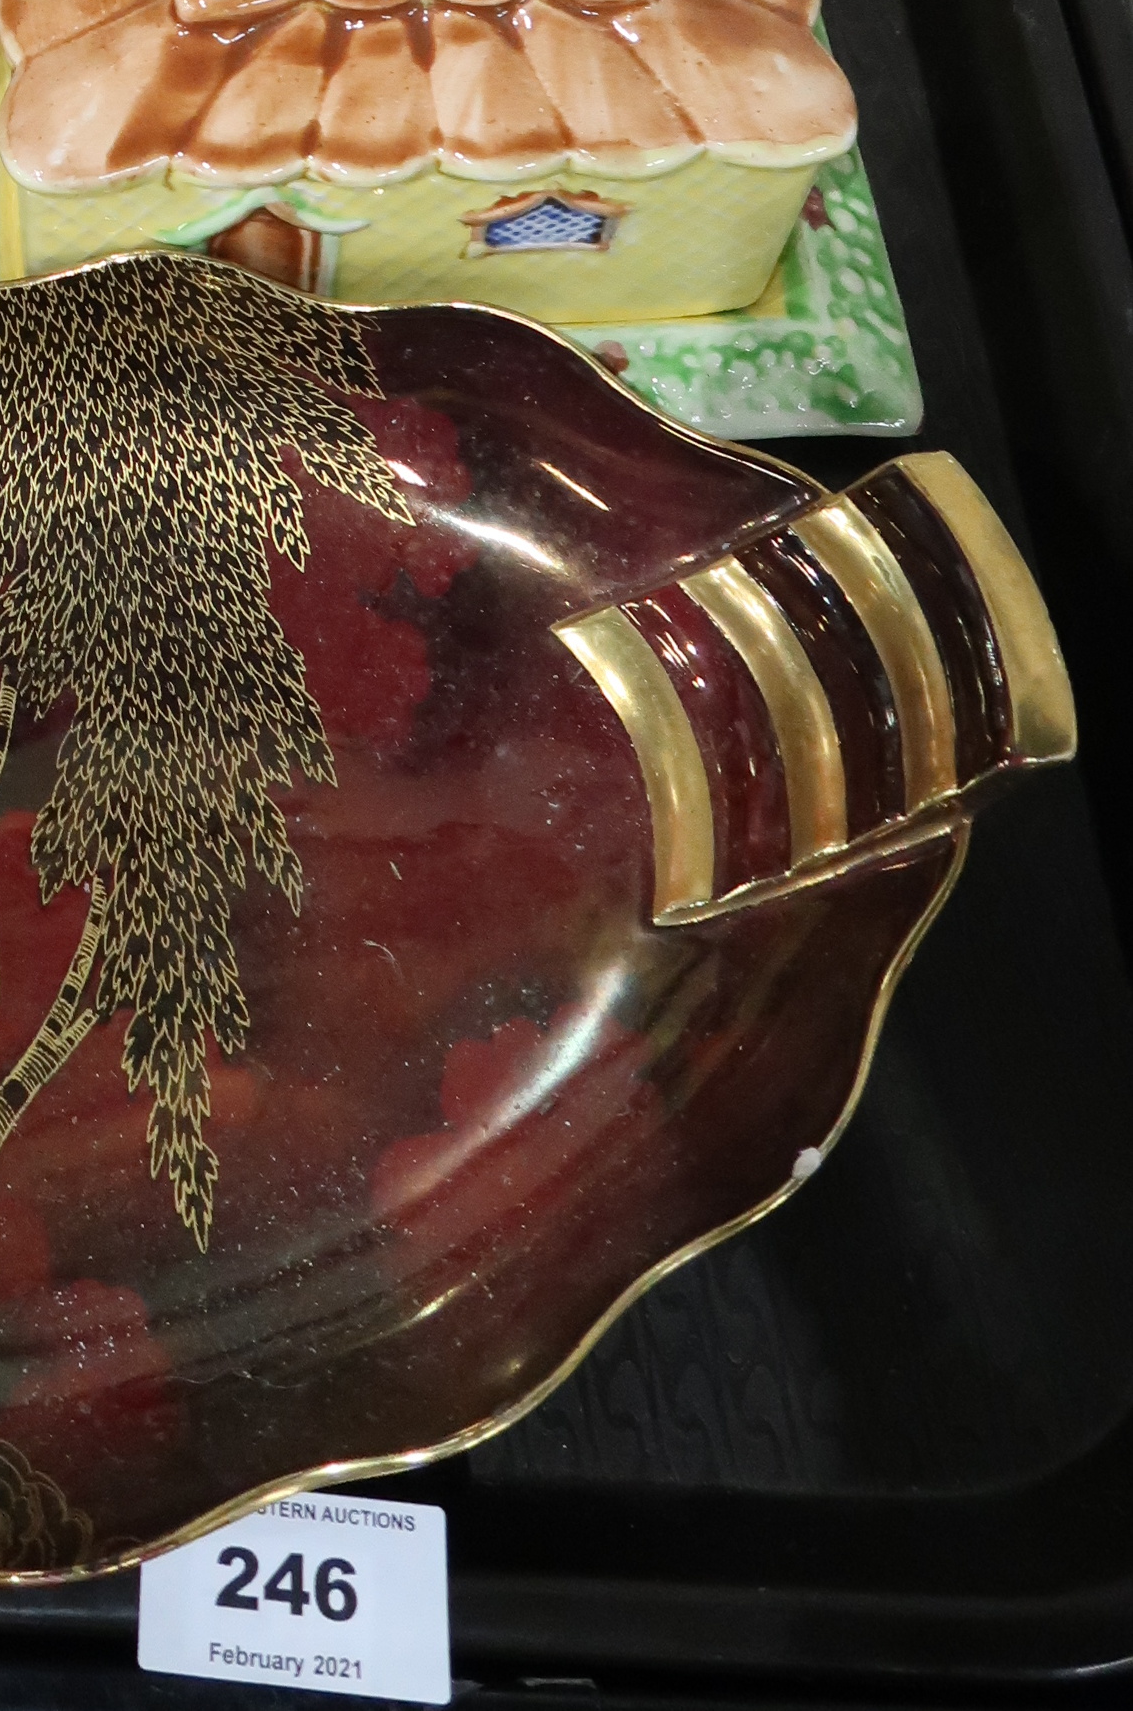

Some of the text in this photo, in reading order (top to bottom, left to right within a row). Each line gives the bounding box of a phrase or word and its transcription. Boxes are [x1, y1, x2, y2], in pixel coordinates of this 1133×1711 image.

[320, 1506, 416, 1532] AUCTIONS
[215, 1545, 358, 1622] 246
[208, 1642, 362, 1679] February 2021
